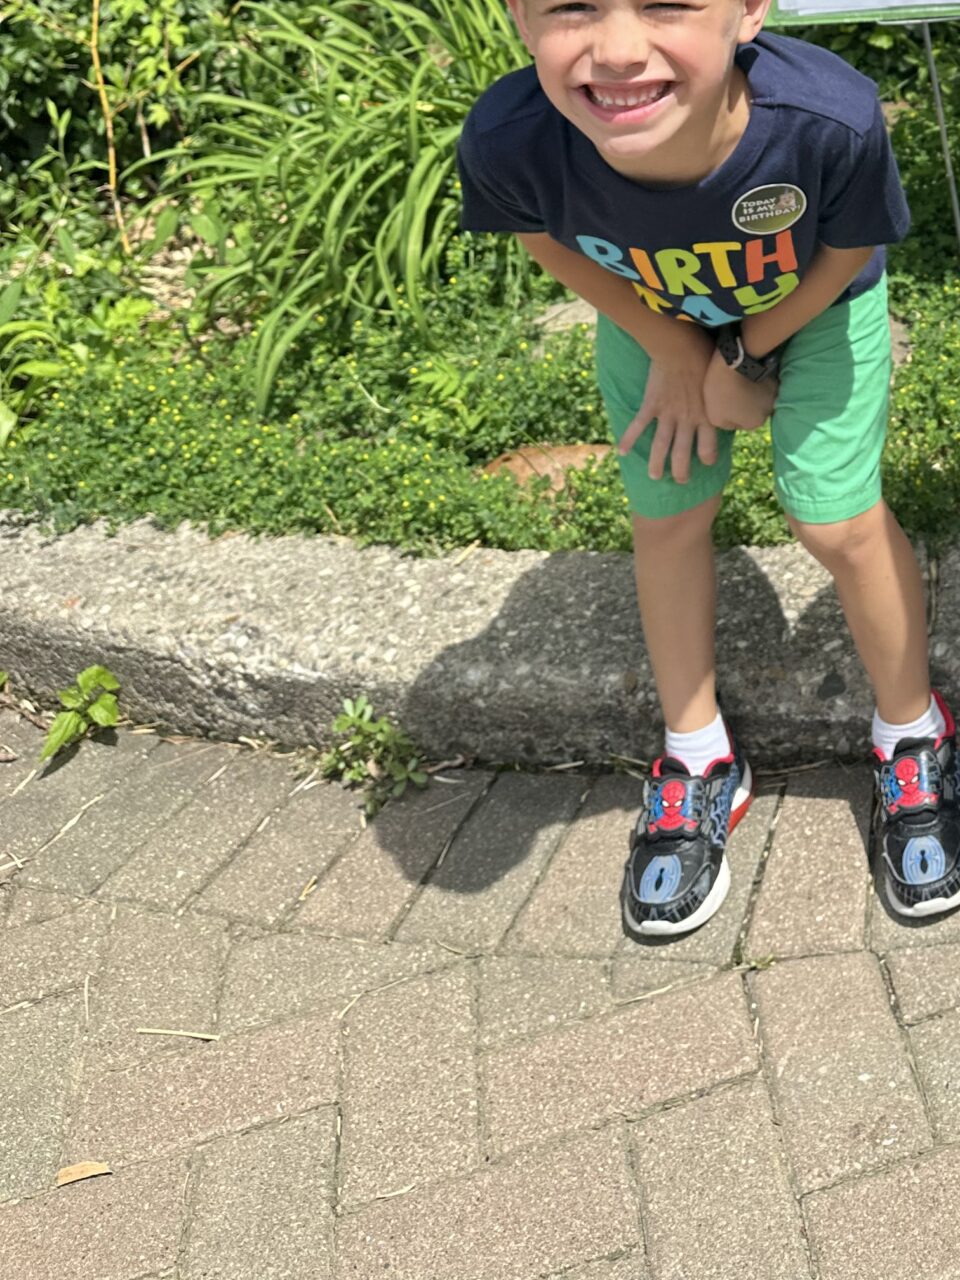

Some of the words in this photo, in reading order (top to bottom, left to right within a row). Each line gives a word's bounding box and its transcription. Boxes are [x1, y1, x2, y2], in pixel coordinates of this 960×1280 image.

[741, 197, 777, 208] TODAY
[743, 207, 755, 215] IS
[756, 203, 776, 213] MY
[575, 229, 799, 297] BIRTH
